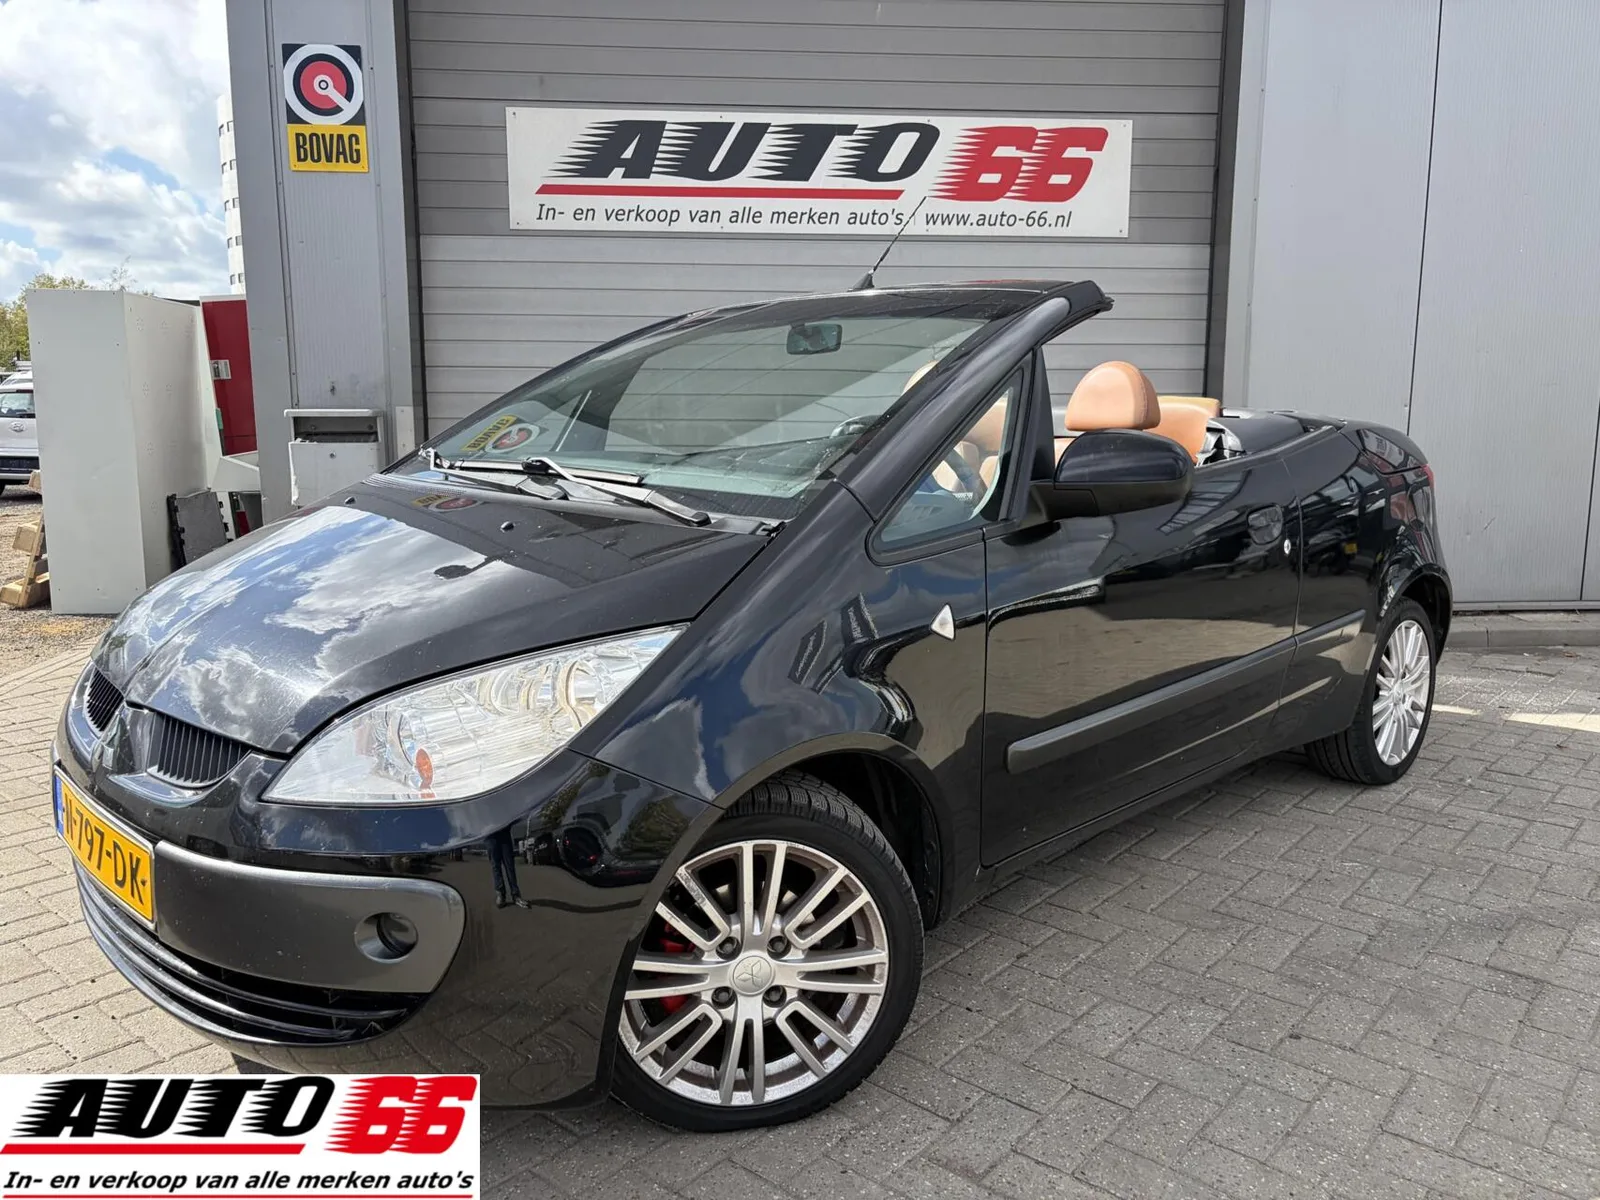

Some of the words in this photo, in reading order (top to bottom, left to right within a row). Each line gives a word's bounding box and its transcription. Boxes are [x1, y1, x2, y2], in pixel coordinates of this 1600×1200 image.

[295, 132, 361, 164] BOVAG
[542, 119, 941, 183] AUTO
[928, 126, 1109, 203] 66
[536, 203, 565, 221] In-
[573, 207, 596, 222] en
[604, 204, 681, 227] verkoop
[689, 209, 723, 224] van
[729, 206, 763, 224] alle
[769, 207, 840, 225] merken
[847, 208, 905, 226] auto's
[925, 210, 1073, 229] www.auto-66.nl
